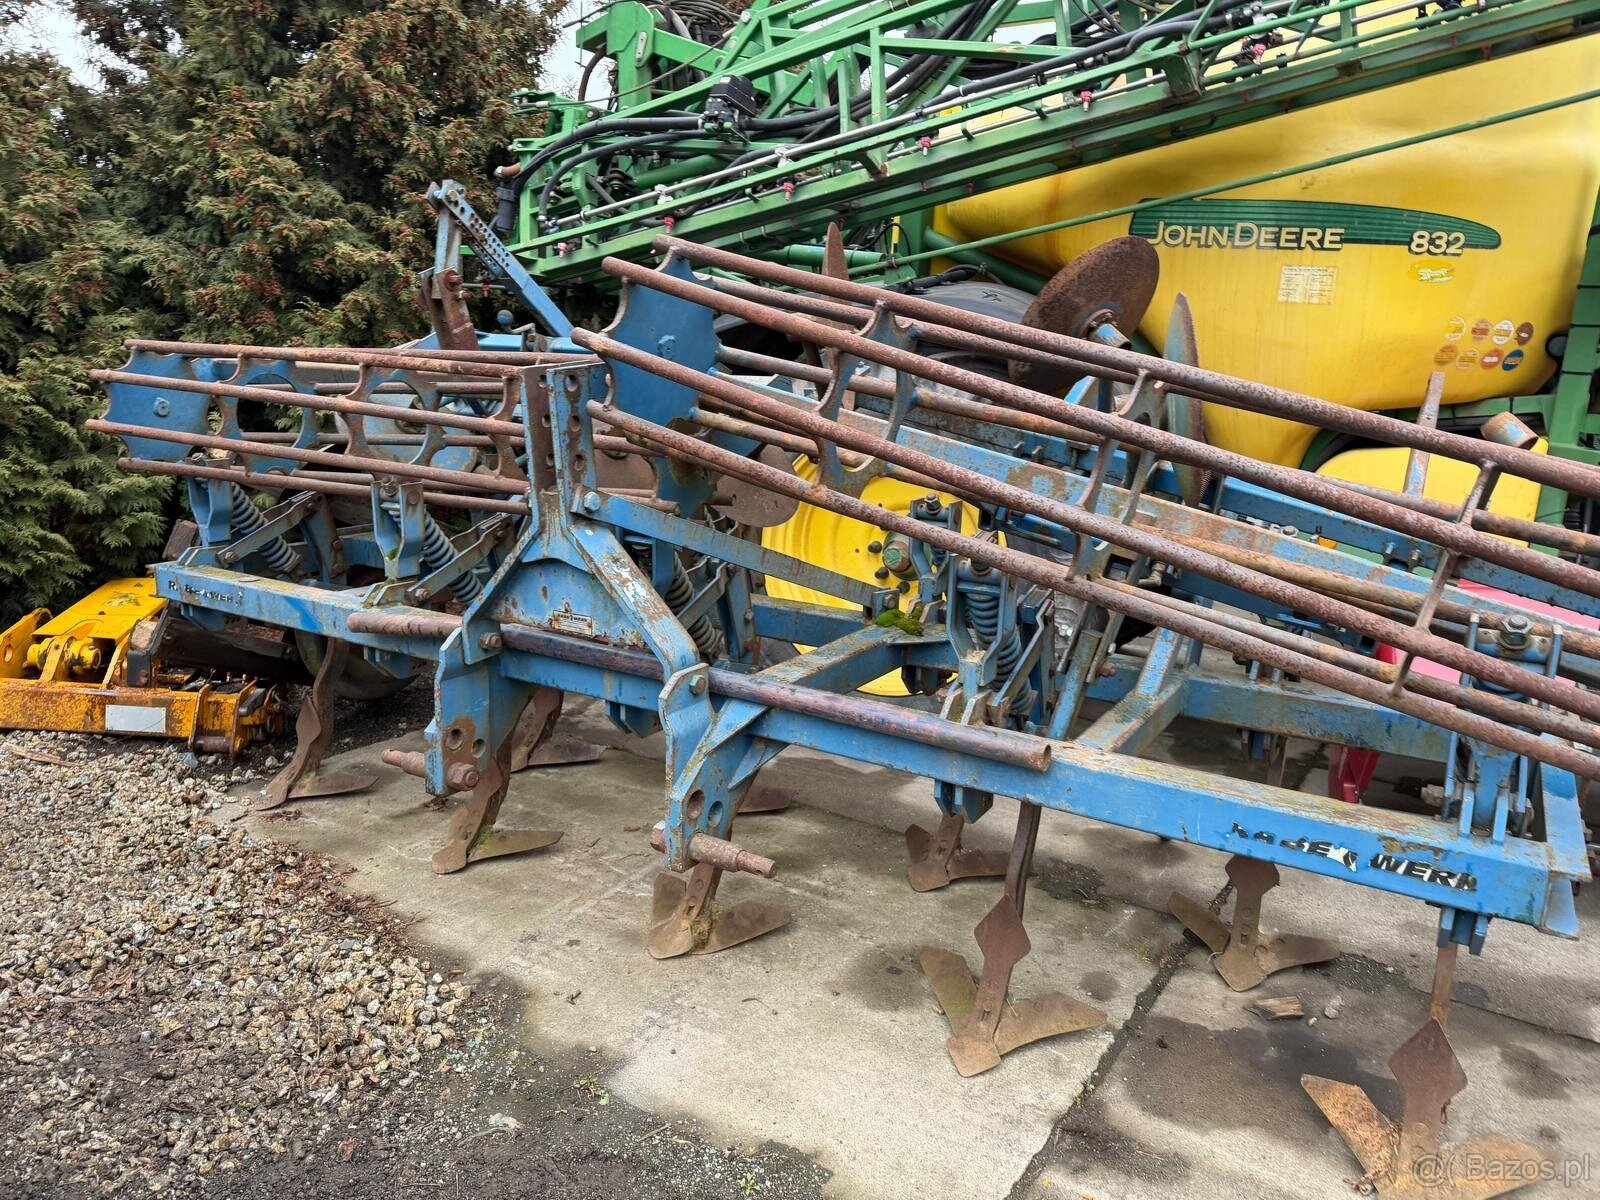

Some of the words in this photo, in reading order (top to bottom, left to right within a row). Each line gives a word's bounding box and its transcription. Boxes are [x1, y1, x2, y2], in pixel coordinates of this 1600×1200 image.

[1148, 219, 1231, 249] JOHN
[1233, 220, 1345, 250] DEERE
[1410, 230, 1467, 255] 832
